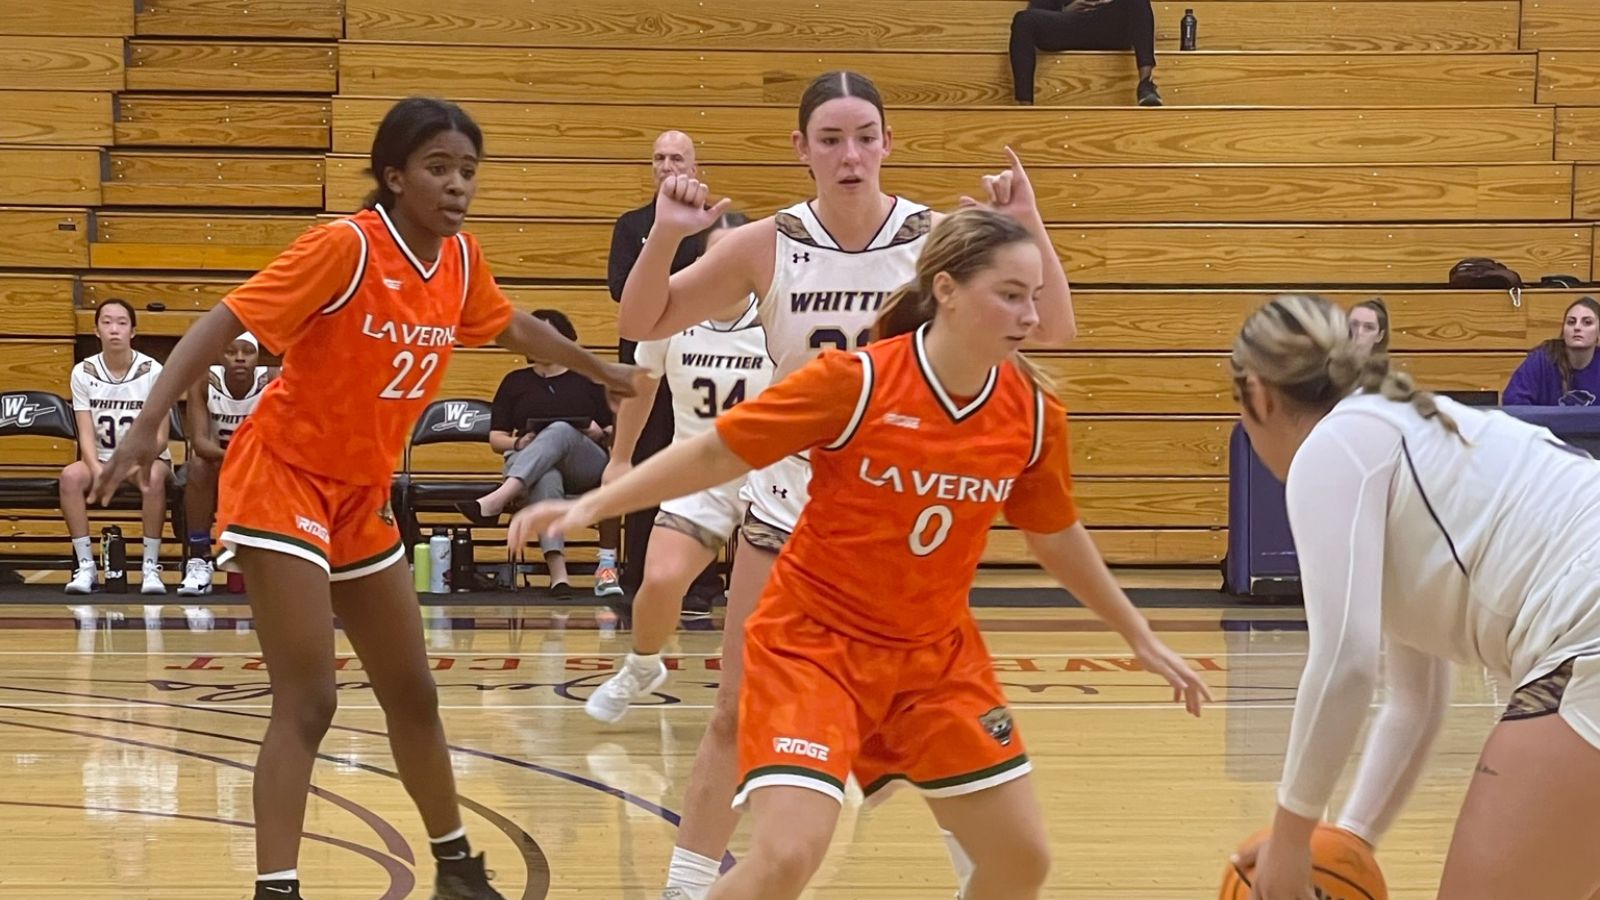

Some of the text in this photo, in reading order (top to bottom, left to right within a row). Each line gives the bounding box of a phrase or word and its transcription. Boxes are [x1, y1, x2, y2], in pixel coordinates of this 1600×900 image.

[790, 291, 893, 313] WHITTI
[362, 313, 398, 343] LA
[379, 350, 439, 399] 22
[681, 353, 764, 370] WHITTIER
[89, 399, 144, 410] WHITTIER
[692, 377, 747, 419] 34
[446, 403, 474, 429] WC
[859, 457, 905, 493] LA
[908, 504, 954, 557] 0
[773, 736, 831, 762] RIDGE
